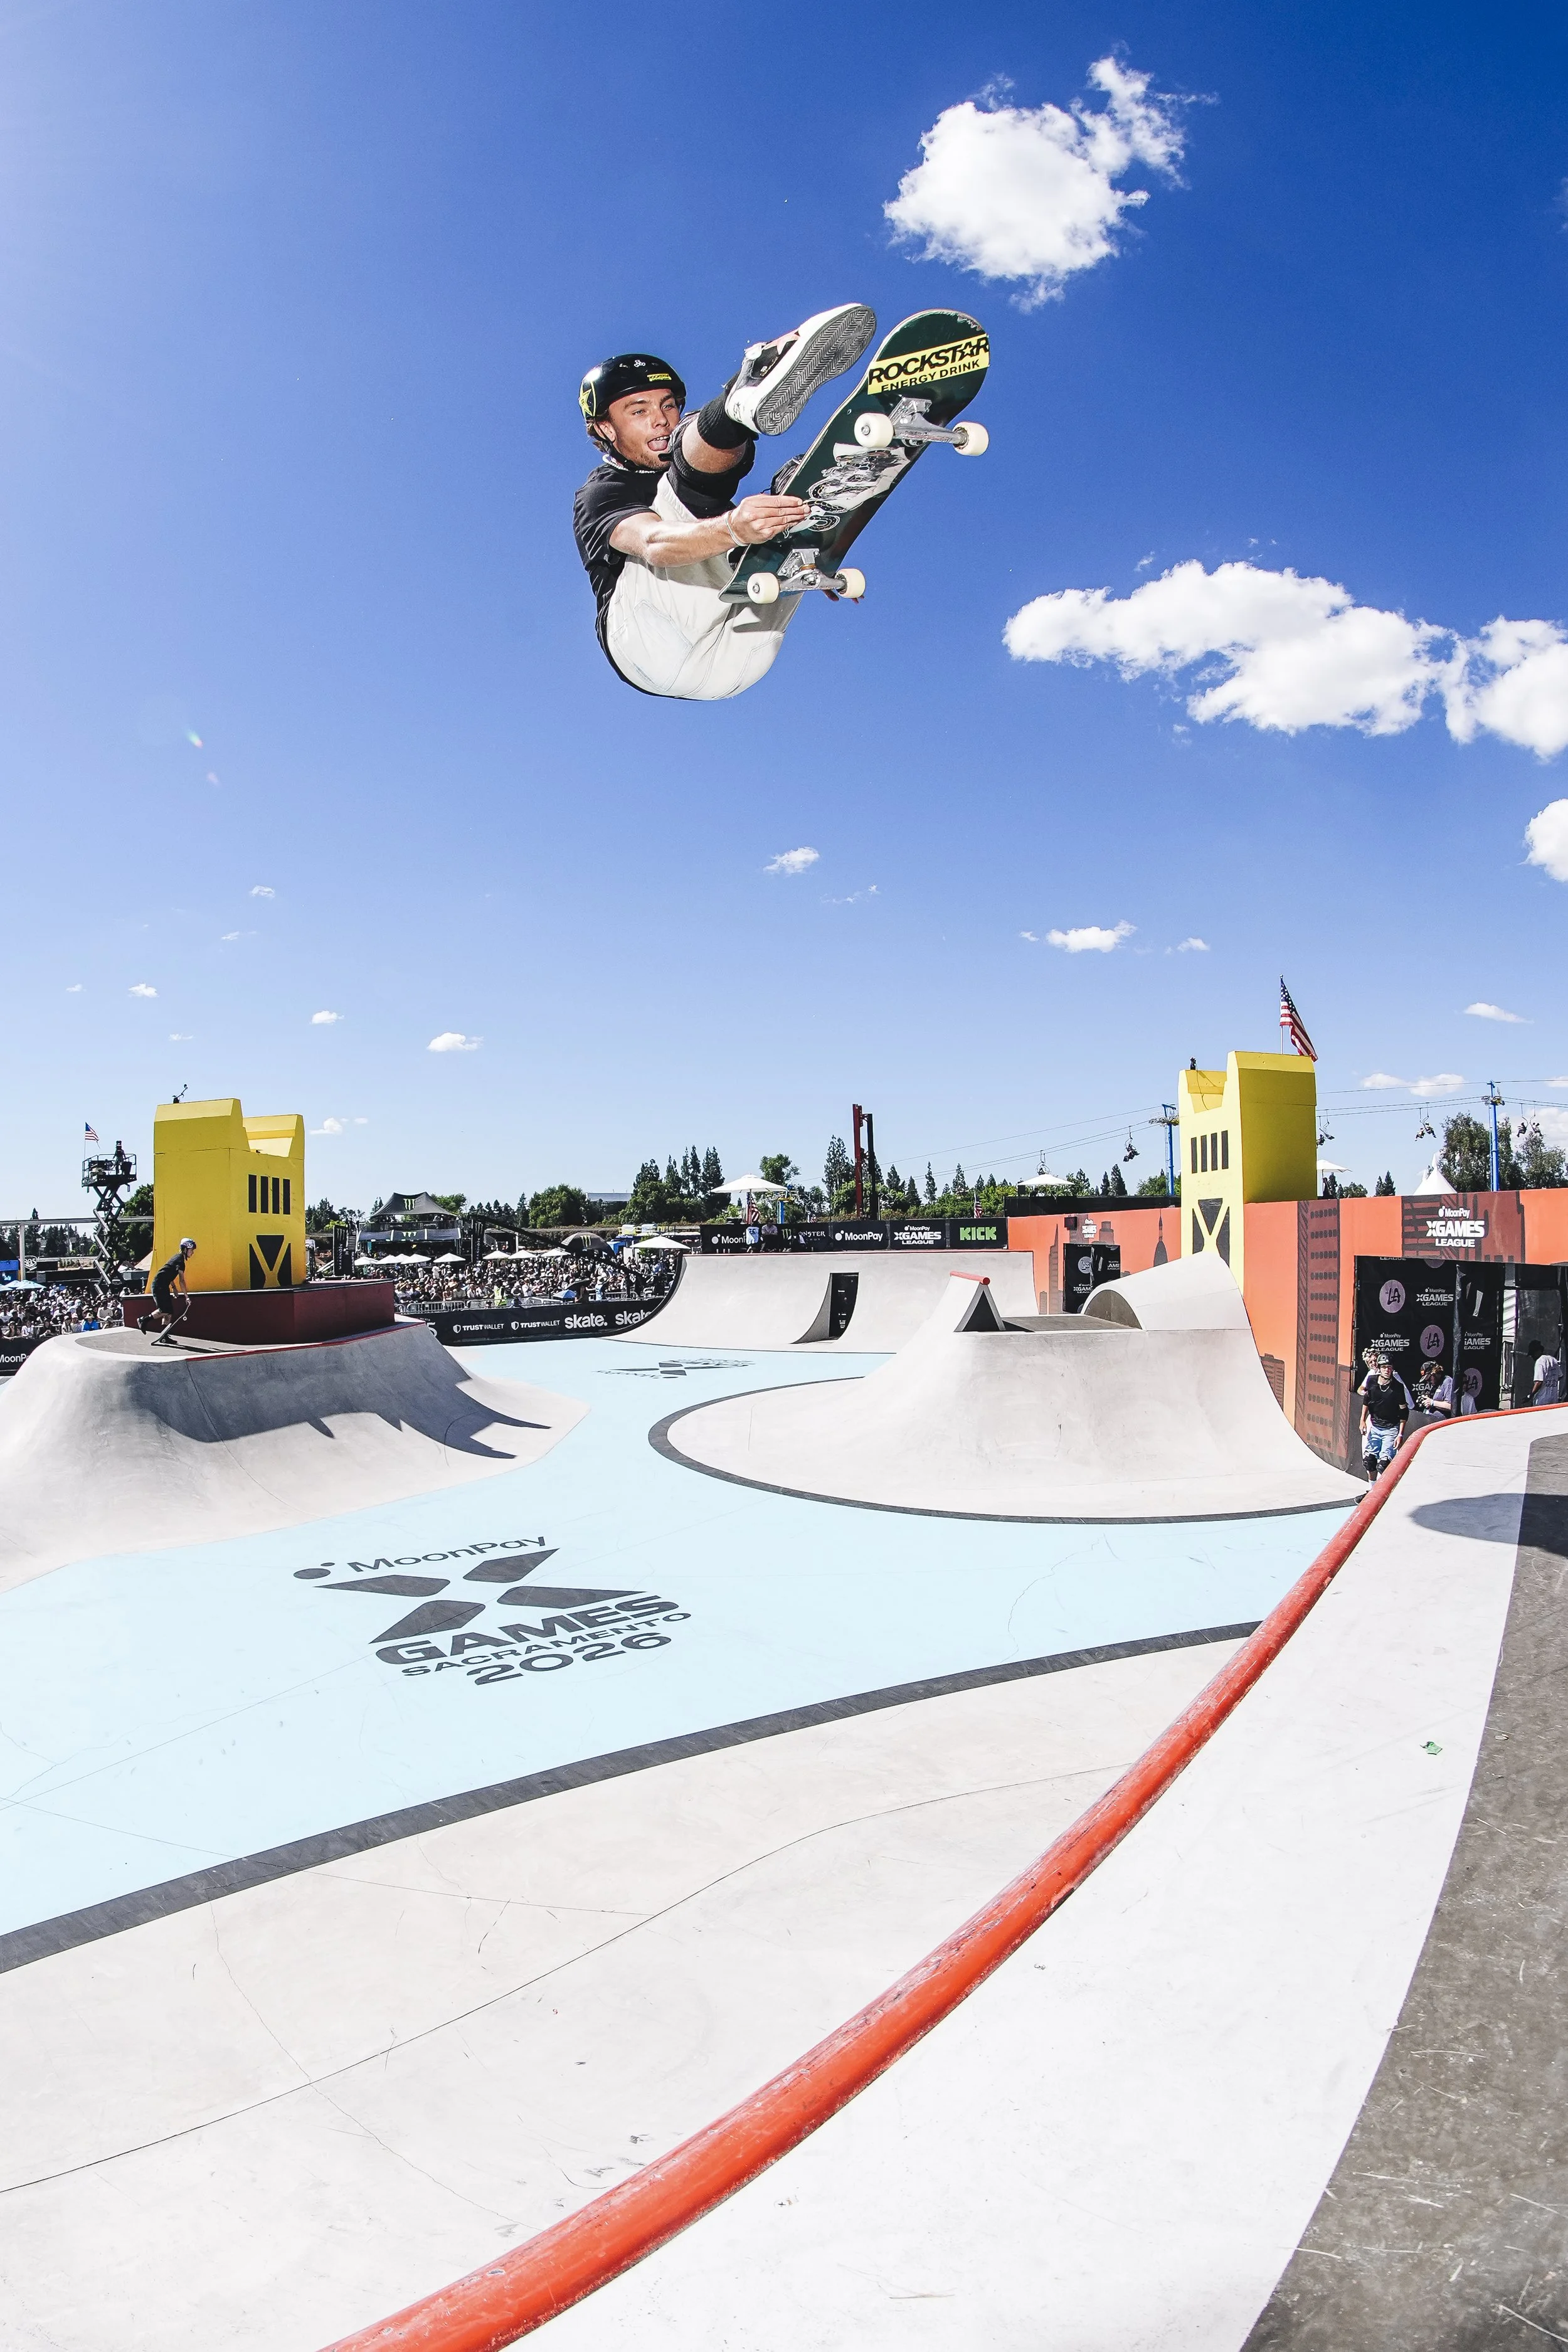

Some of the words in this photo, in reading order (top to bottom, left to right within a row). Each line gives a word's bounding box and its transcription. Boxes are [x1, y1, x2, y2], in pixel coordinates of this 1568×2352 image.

[869, 336, 989, 385] ROCKSTAR
[881, 371, 936, 393] ENERGY
[940, 359, 980, 378] DRINK
[1426, 1221, 1485, 1237] XGAMES
[1444, 1208, 1470, 1219] MoonPay
[845, 1231, 883, 1241] MoonPay
[960, 1227, 997, 1241] KICK
[1435, 1238, 1475, 1248] LEAGUE
[347, 1536, 546, 1572] MoonPay
[376, 1595, 679, 1665] GAMES
[401, 1613, 691, 1677] SACRAMENTO
[467, 1633, 672, 1686] 2026
